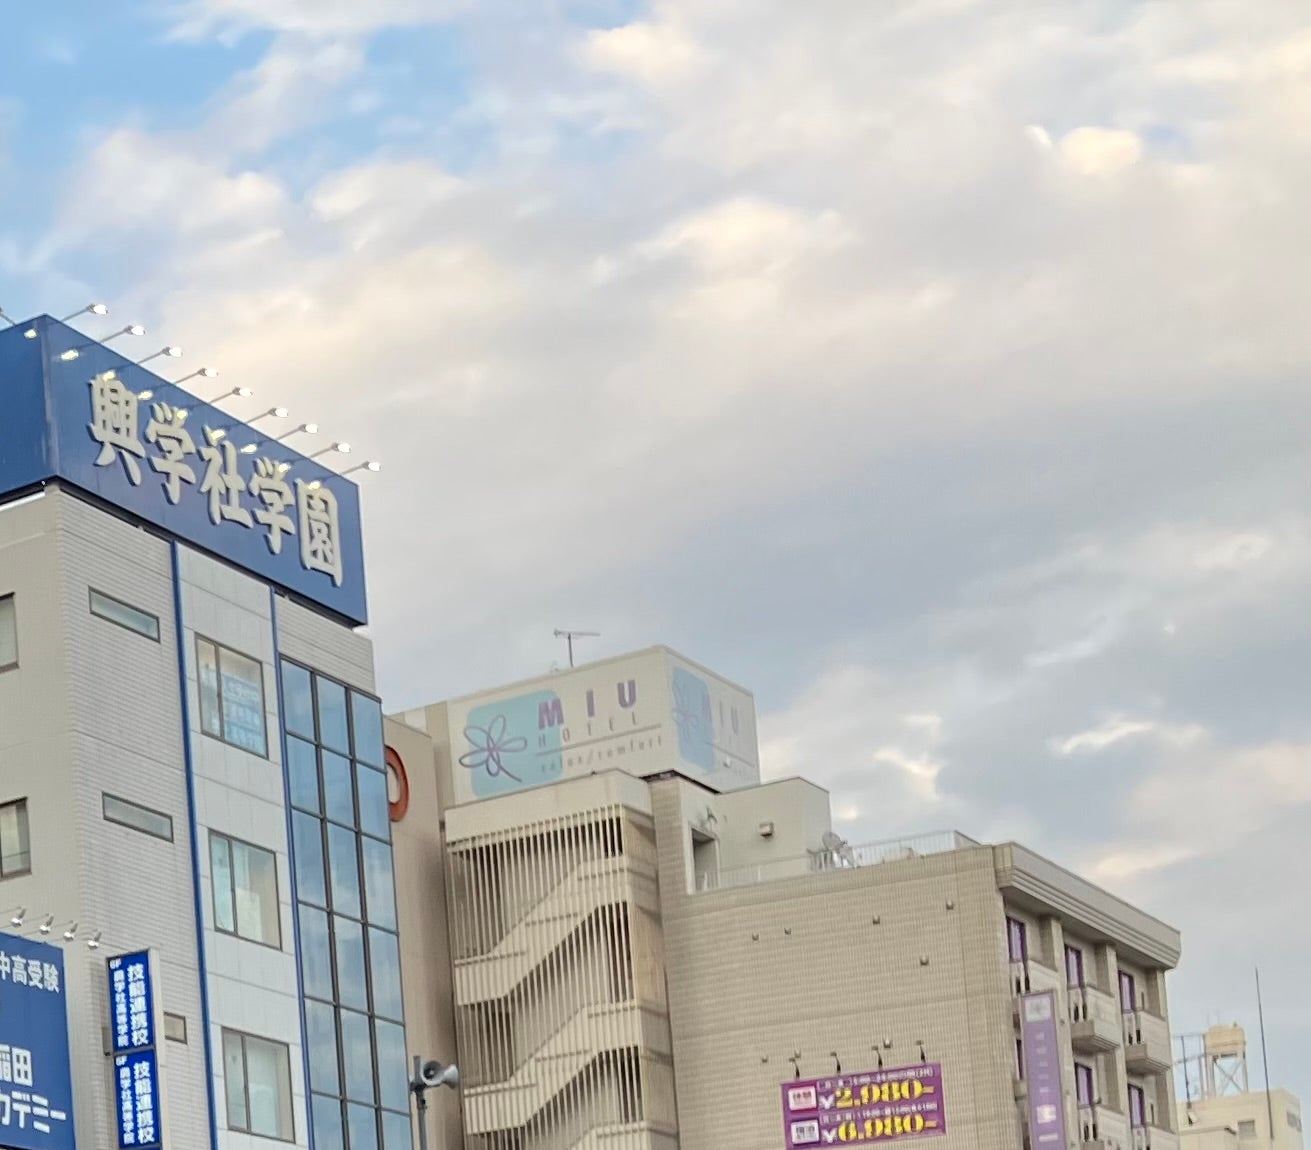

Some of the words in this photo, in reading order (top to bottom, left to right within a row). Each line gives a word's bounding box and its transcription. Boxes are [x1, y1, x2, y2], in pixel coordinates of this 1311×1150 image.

[87, 373, 344, 588] 興学社学園
